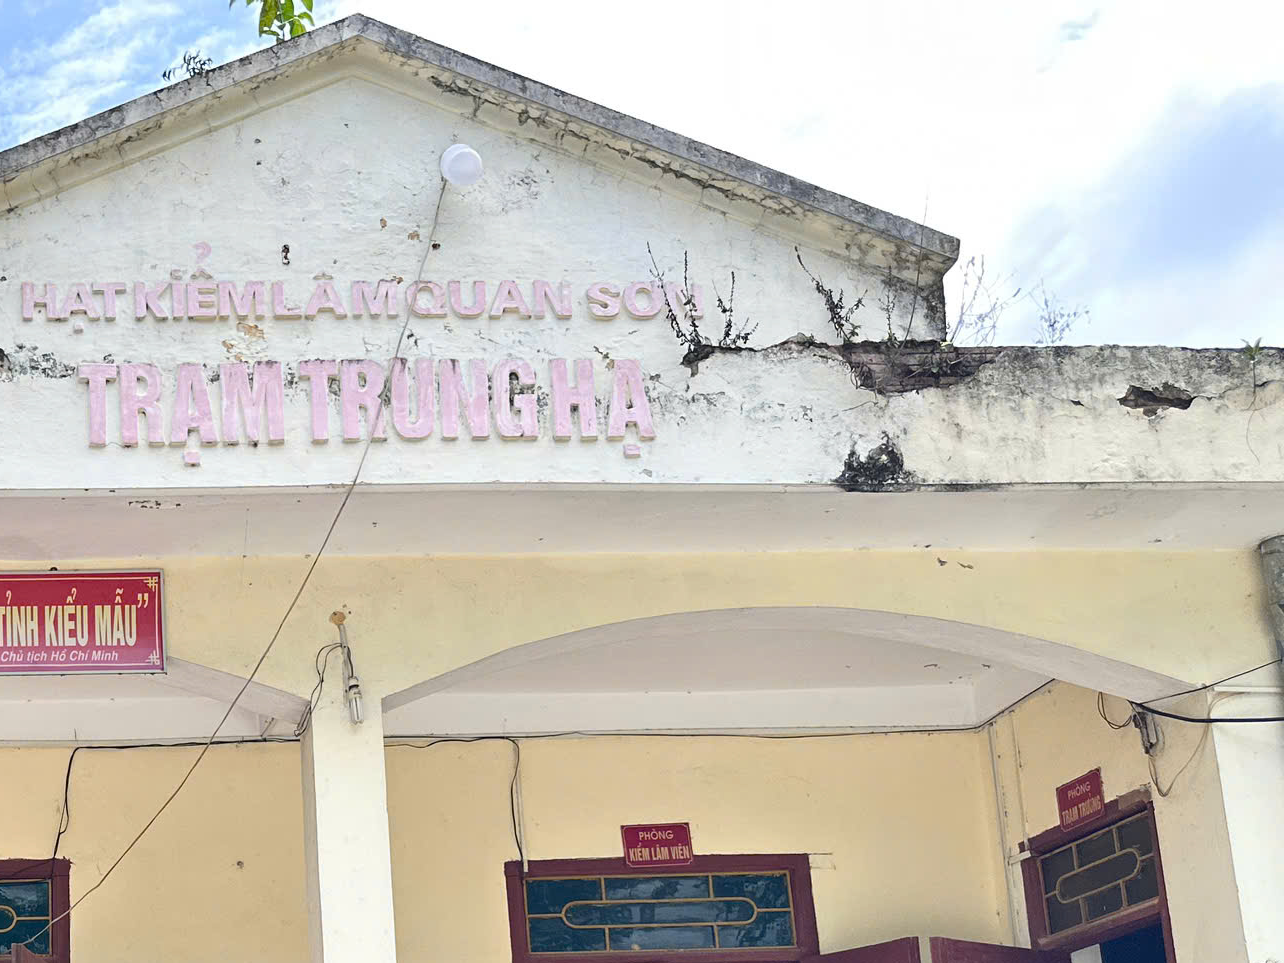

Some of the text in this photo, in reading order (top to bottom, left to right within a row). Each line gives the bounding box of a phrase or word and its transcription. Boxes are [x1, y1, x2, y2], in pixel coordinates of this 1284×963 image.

[21, 281, 125, 334] HẠT
[133, 242, 265, 322] KIỂM
[272, 272, 397, 321] LÂM
[405, 280, 572, 320] QUAN
[77, 357, 656, 467] TRẠM TRUNG HẠ
[44, 587, 89, 646] KIỂU
[0, 648, 119, 663] Chủ tịch Hồ Chí Minh
[1067, 781, 1092, 801] PHÒNG
[638, 829, 674, 841] PHÒNG
[628, 842, 690, 862] KIỂM LÂM VIÊN
